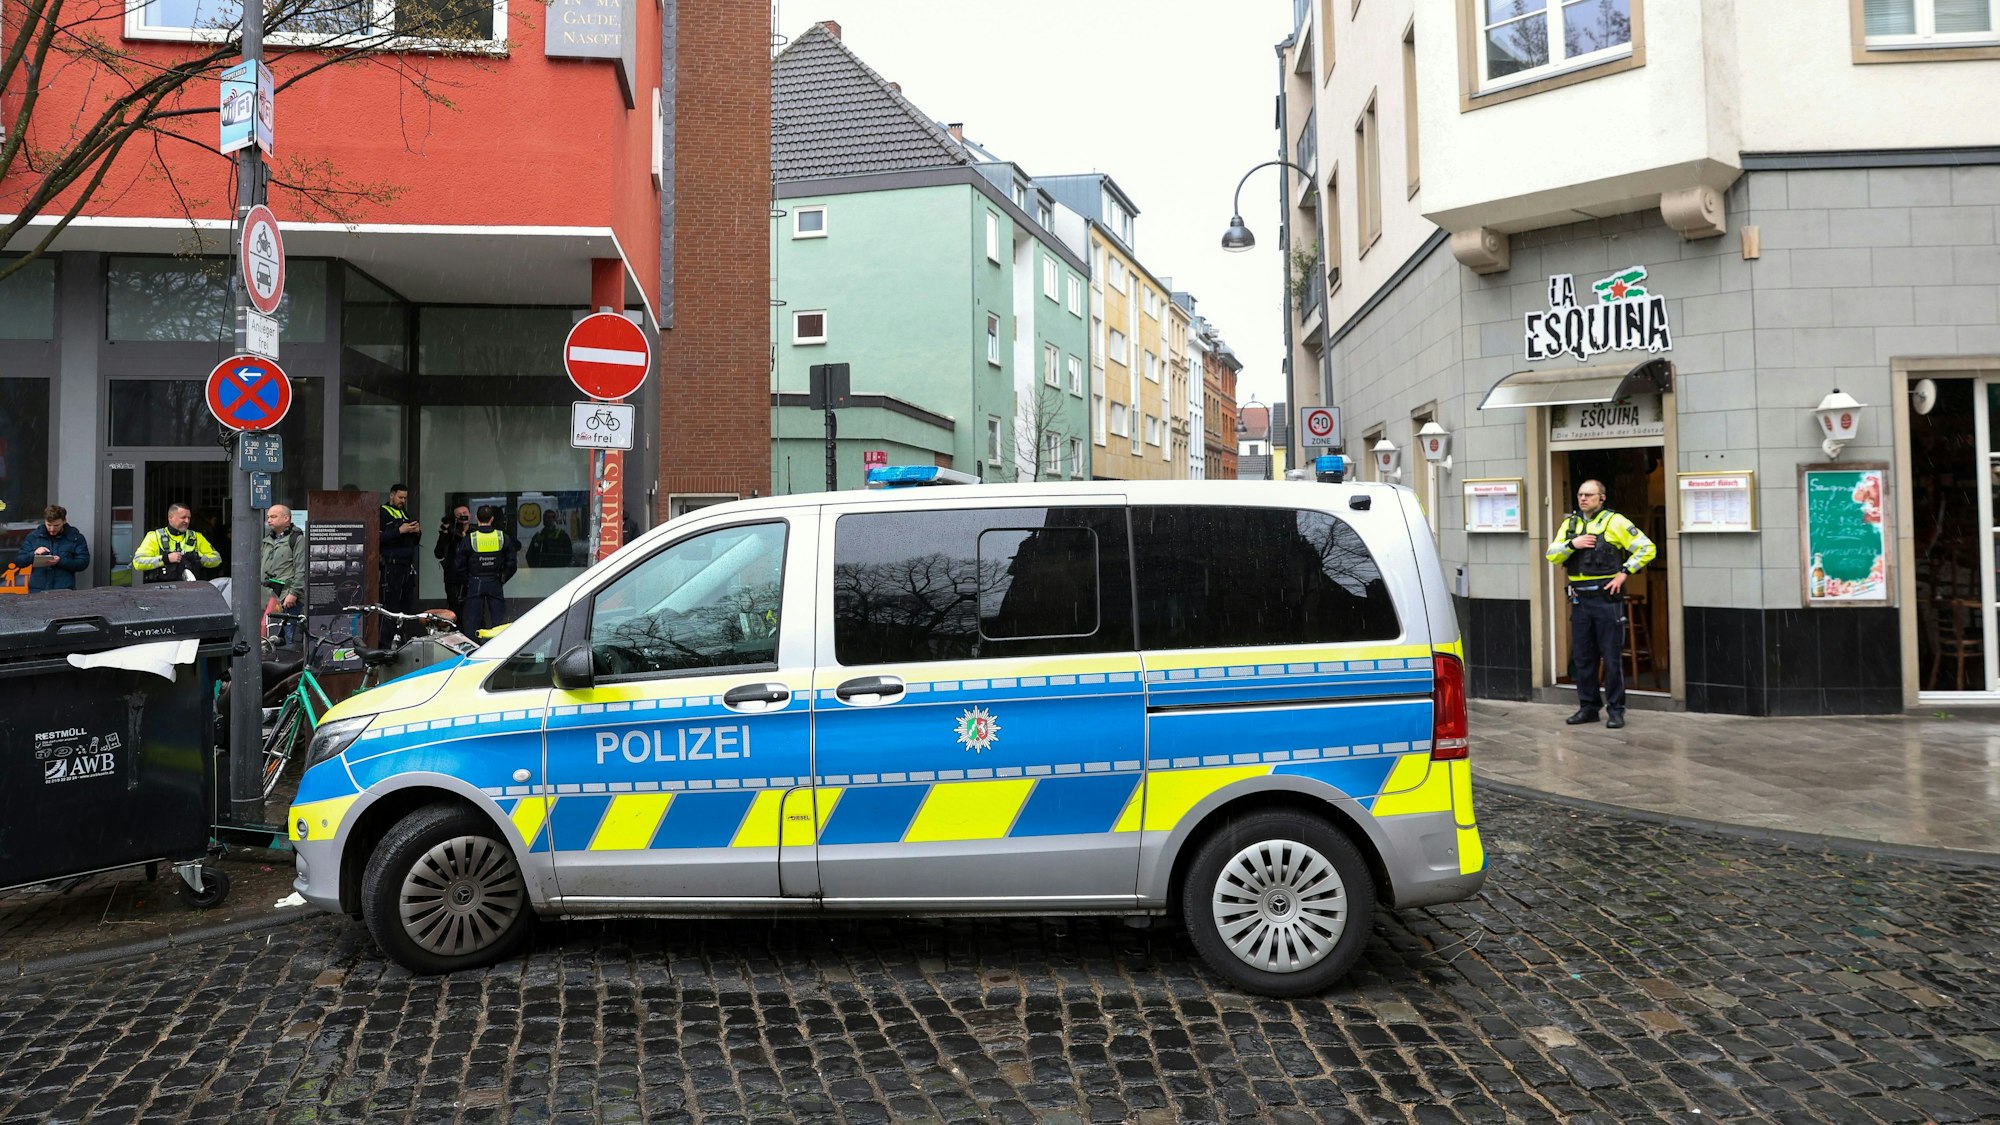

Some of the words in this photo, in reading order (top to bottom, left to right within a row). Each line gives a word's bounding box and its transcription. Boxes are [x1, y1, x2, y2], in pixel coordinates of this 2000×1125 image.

[1550, 276, 1574, 307] LA
[1527, 298, 1669, 359] ESQUINA
[259, 337, 268, 350] frei
[1313, 417, 1328, 429] 30
[1580, 406, 1640, 428] ESQUINA
[594, 433, 612, 443] frei
[35, 728, 87, 741] RESTMÜLL
[596, 725, 750, 764] POLIZEI
[70, 753, 115, 776] AWB
